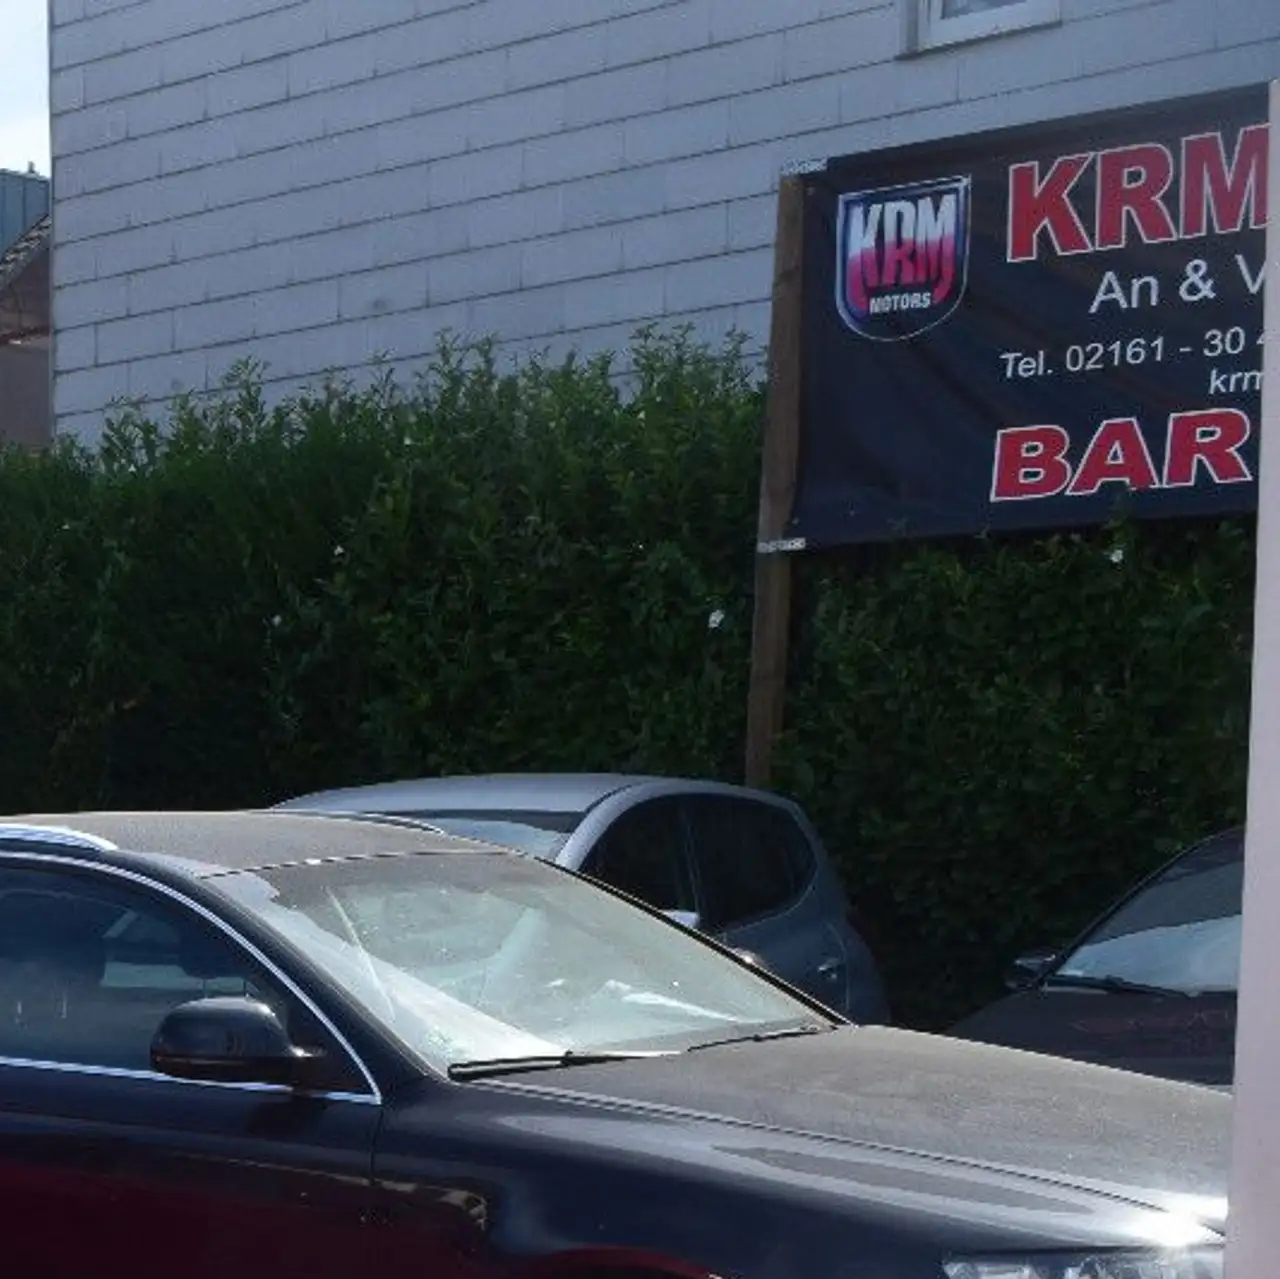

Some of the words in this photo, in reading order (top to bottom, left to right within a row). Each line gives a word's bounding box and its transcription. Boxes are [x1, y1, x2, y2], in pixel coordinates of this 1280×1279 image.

[1007, 123, 1269, 262] KRM
[847, 194, 957, 312] KRM
[1090, 271, 1159, 313] An
[1179, 260, 1217, 301] &
[870, 291, 931, 315] MOTORS
[1000, 352, 1053, 379] Tel.
[1066, 336, 1164, 372] 02161
[1203, 327, 1246, 357] 30
[989, 408, 1252, 502] BAR
